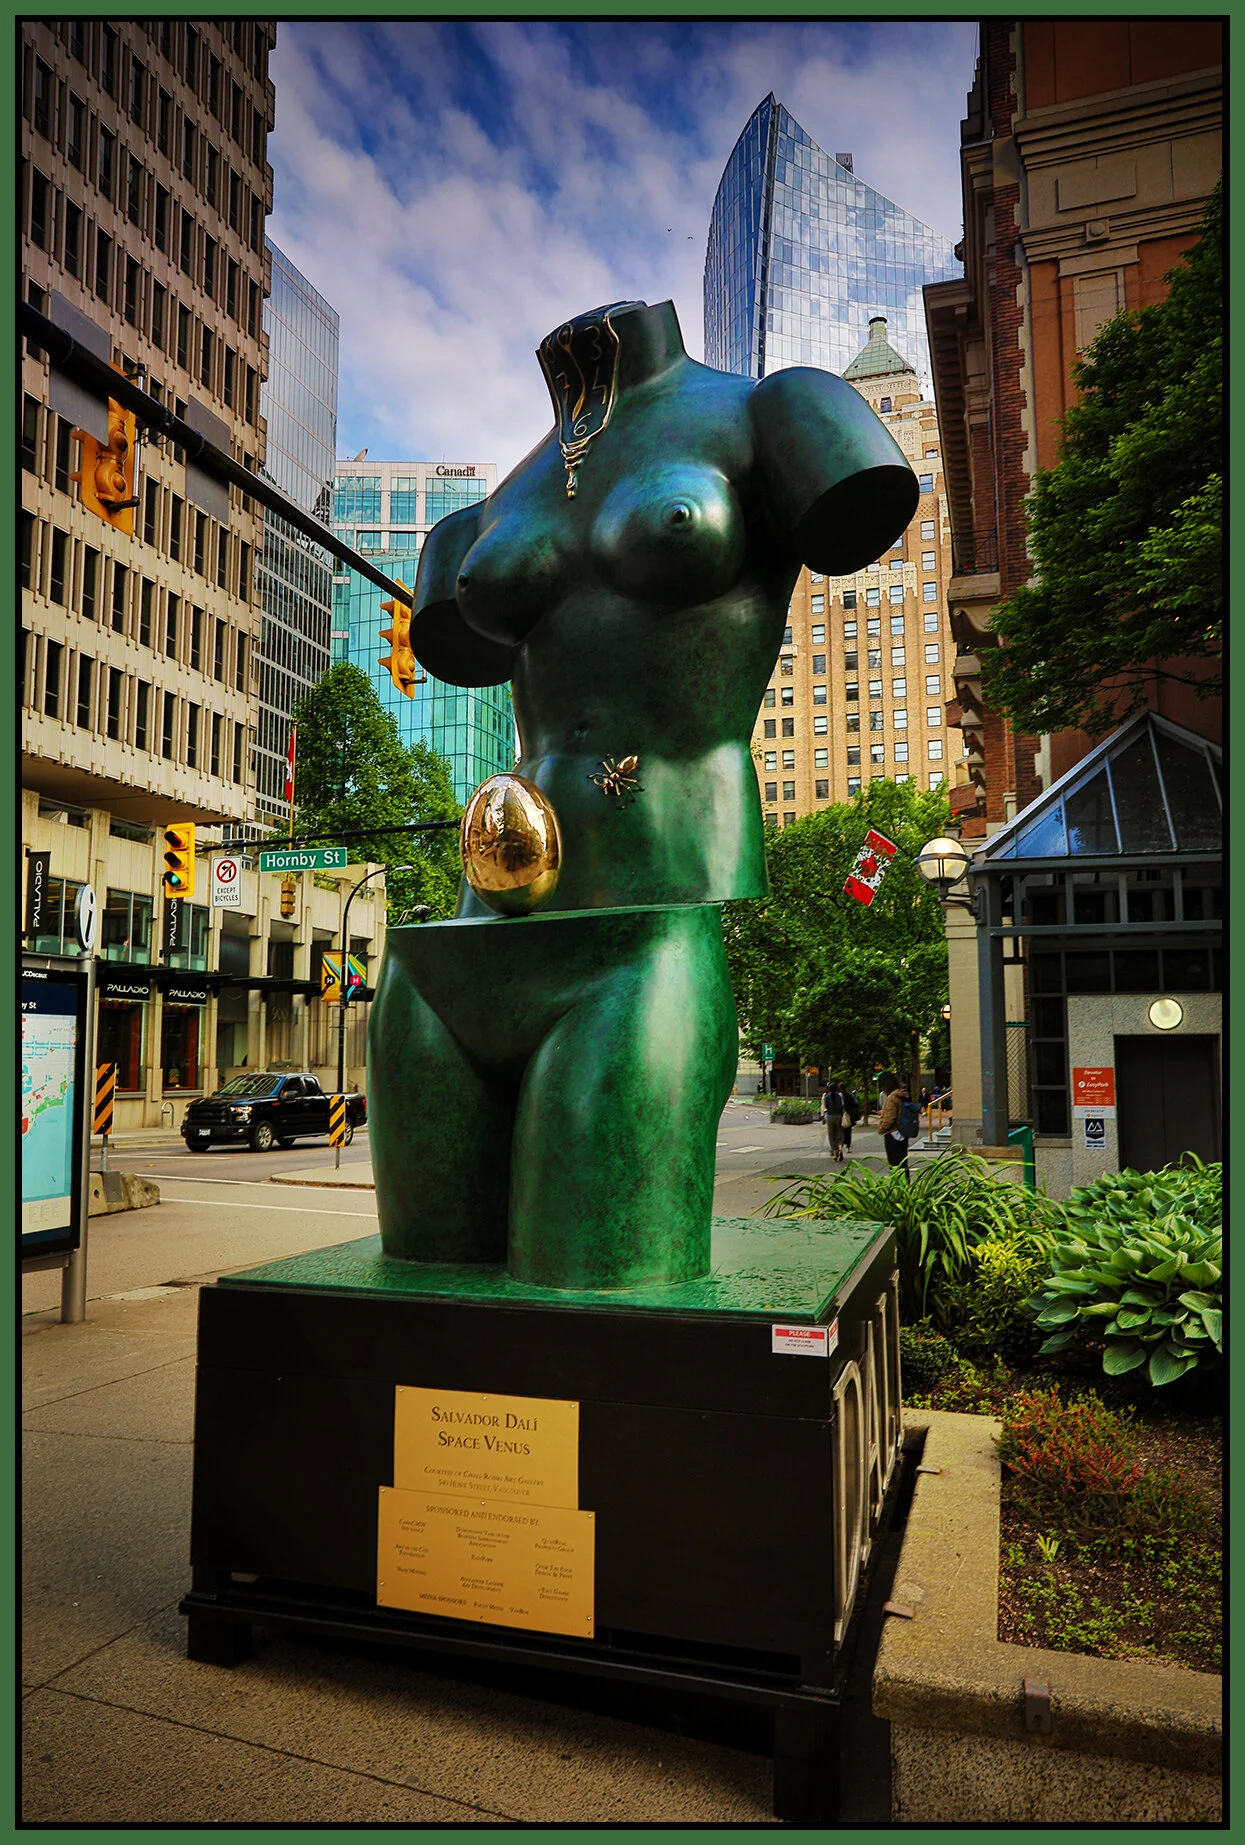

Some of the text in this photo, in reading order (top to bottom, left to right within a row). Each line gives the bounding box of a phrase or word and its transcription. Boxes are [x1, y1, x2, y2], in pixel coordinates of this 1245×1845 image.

[573, 412, 592, 436] 6
[436, 465, 475, 477] Canada
[266, 850, 340, 868] Hornby St
[33, 860, 43, 927] PALLADIO
[170, 896, 178, 946] PALLADI
[22, 970, 48, 979] JCDecaux
[106, 984, 149, 994] PALLADIO
[169, 989, 206, 999] PALLADIO
[29, 1001, 37, 1009] St
[431, 1406, 539, 1431] SALVADOR DALÍ
[438, 1430, 531, 1455] SPACE VENUS
